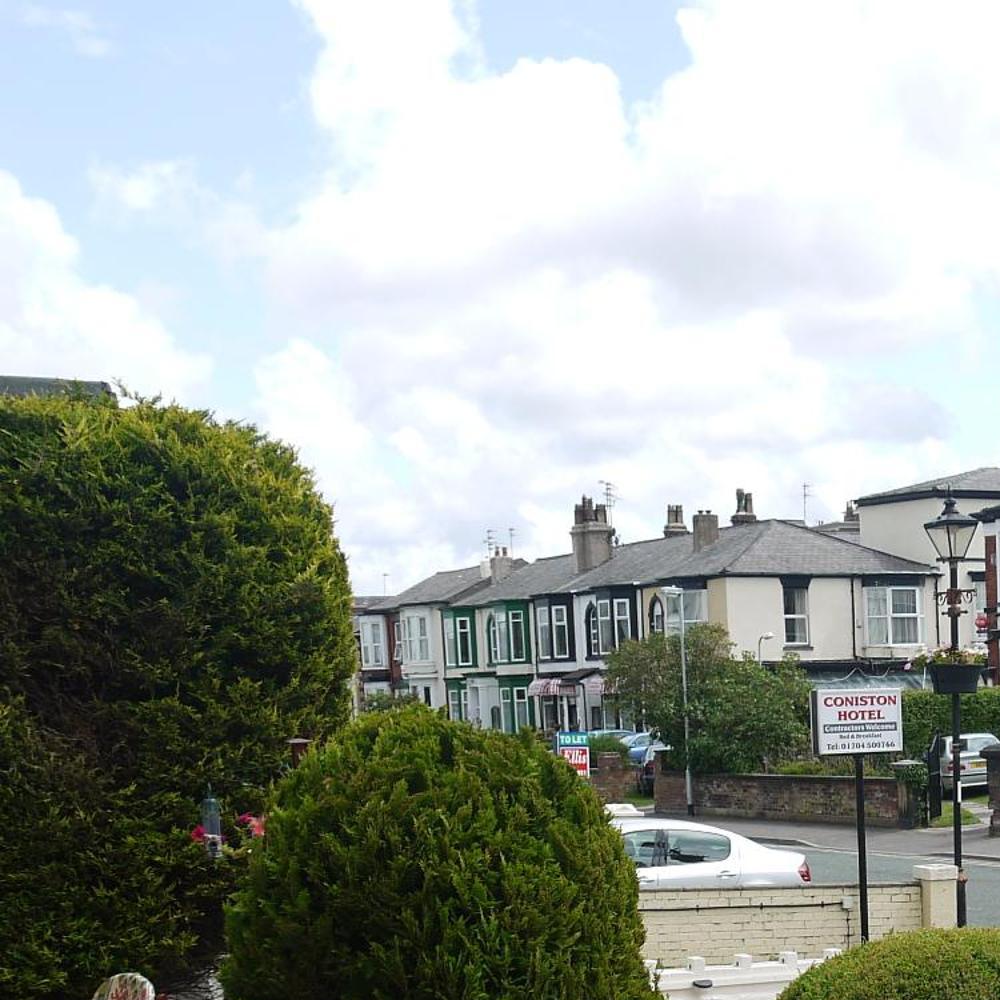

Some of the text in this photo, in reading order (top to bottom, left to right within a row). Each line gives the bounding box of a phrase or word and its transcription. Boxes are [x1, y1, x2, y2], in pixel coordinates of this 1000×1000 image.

[824, 696, 896, 707] CONISTON
[838, 710, 885, 721] HOTEL
[560, 735, 587, 744] TO LET
